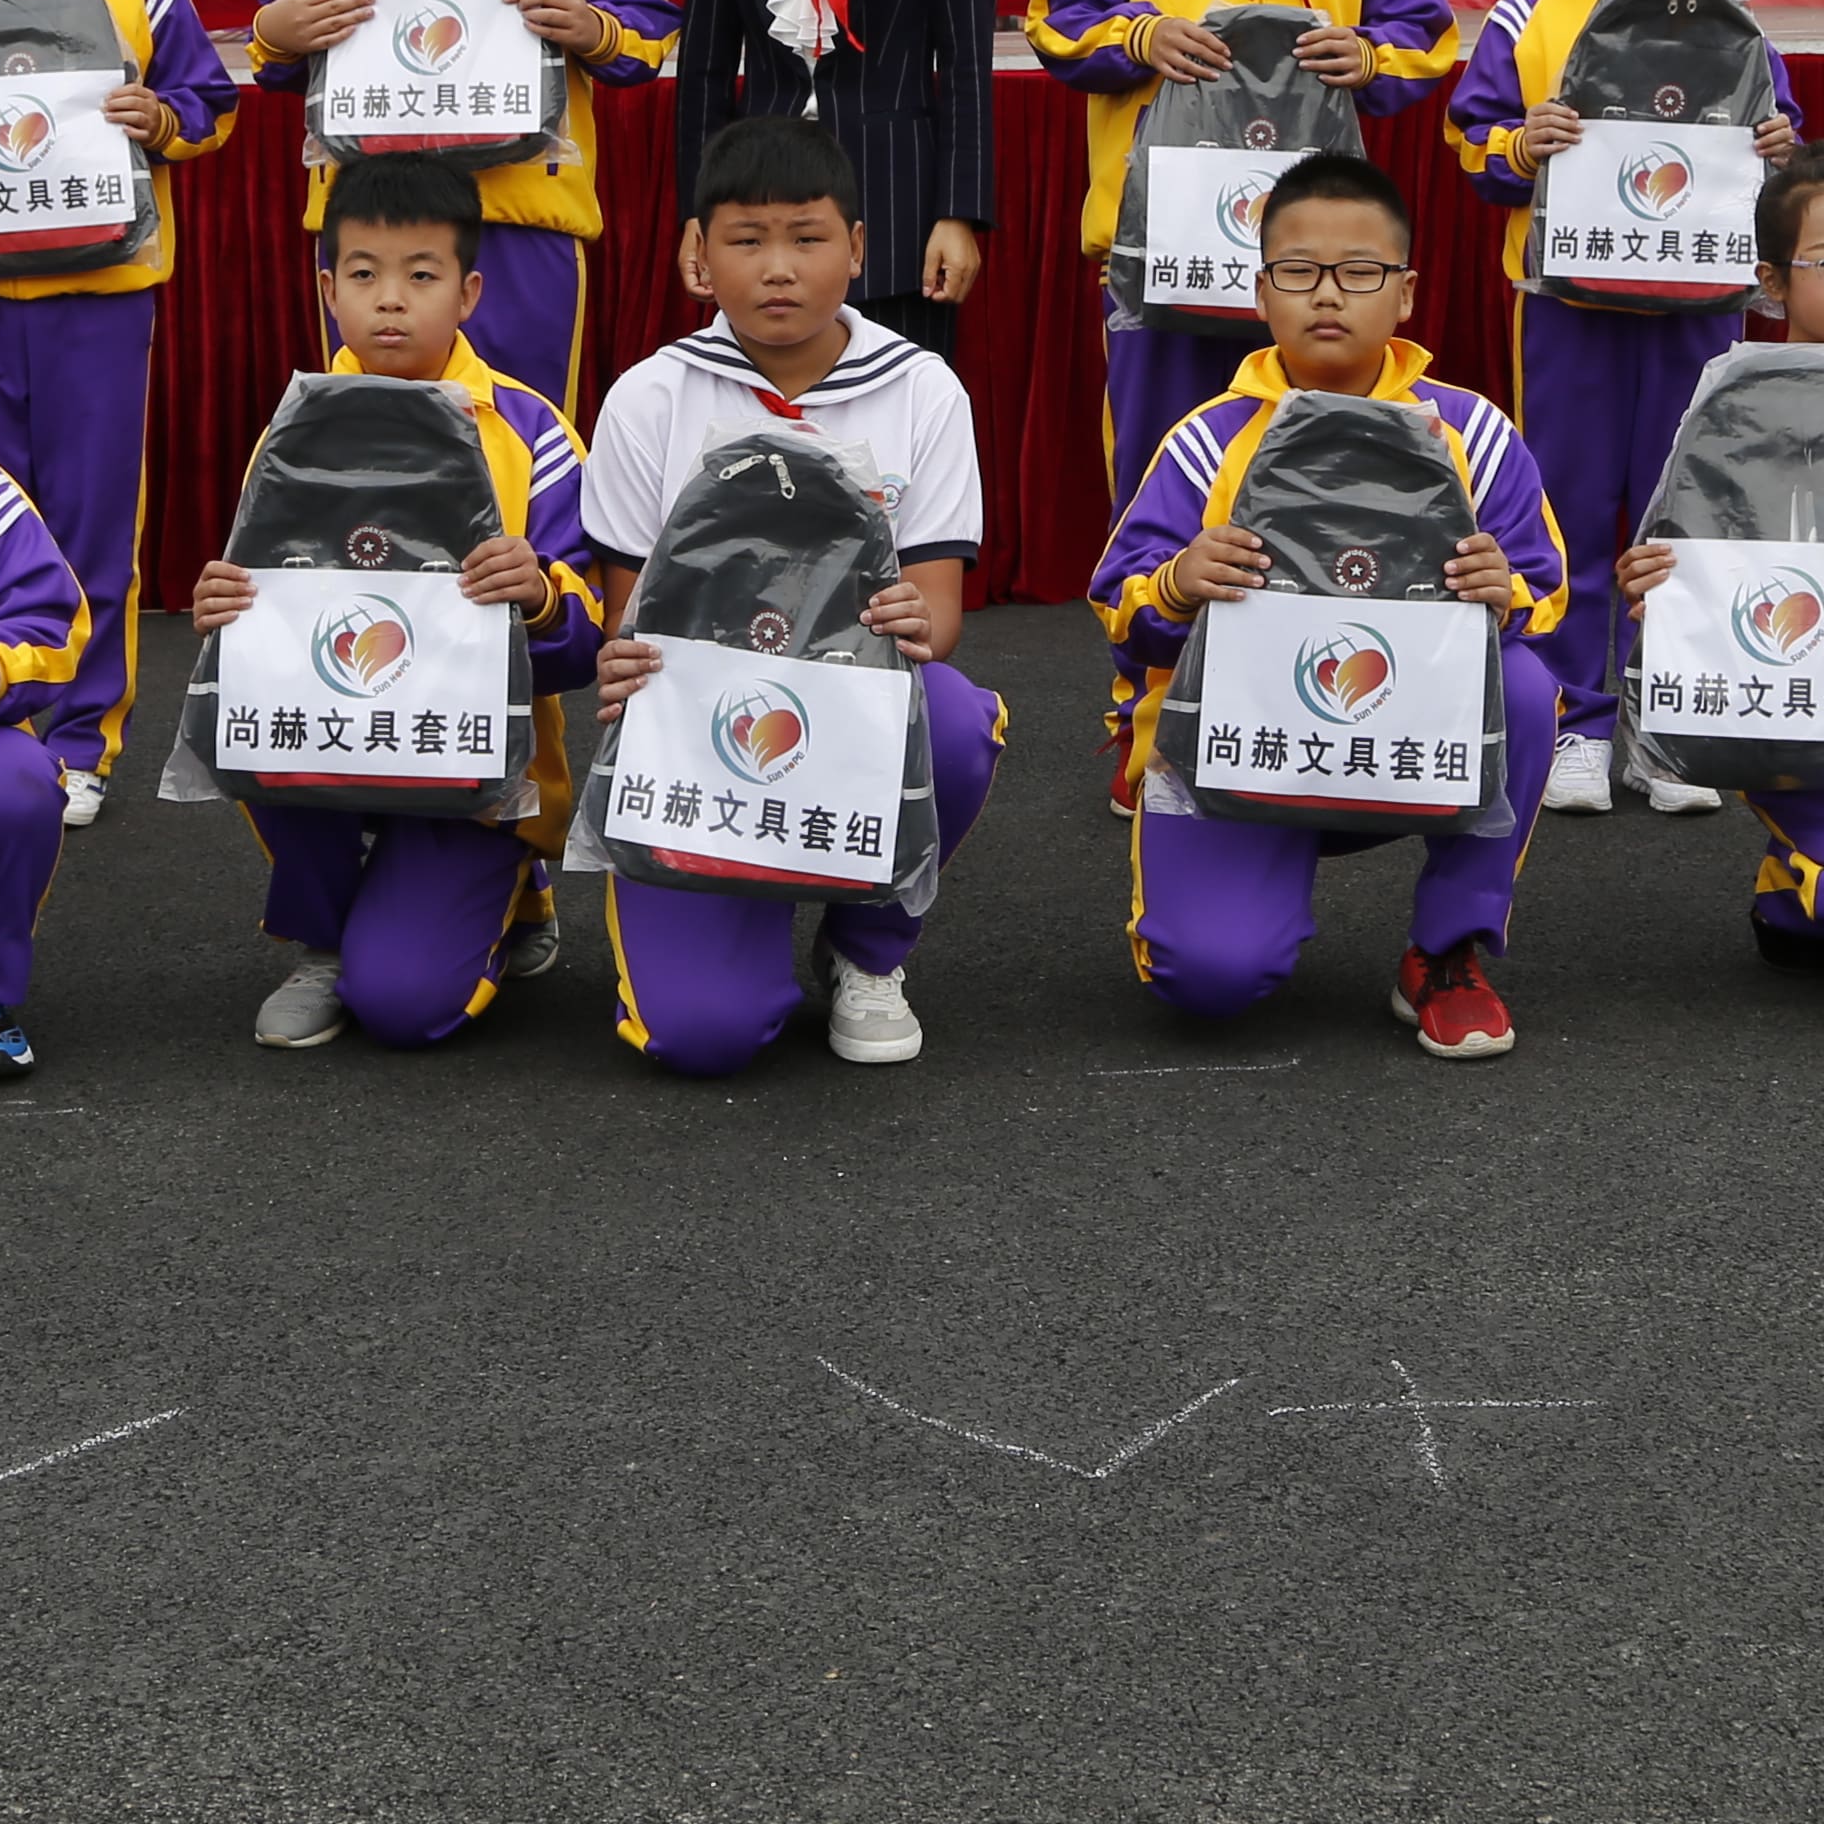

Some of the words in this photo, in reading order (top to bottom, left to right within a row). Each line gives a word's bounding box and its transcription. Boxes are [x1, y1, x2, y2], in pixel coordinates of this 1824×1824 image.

[330, 82, 532, 119] 尚赫文具套组
[1551, 226, 1754, 264] 尚赫文具套组
[225, 705, 494, 755] 尚赫文具套组
[1206, 723, 1469, 782] 尚赫文具套组
[616, 773, 883, 858] 尚赫文具套组
